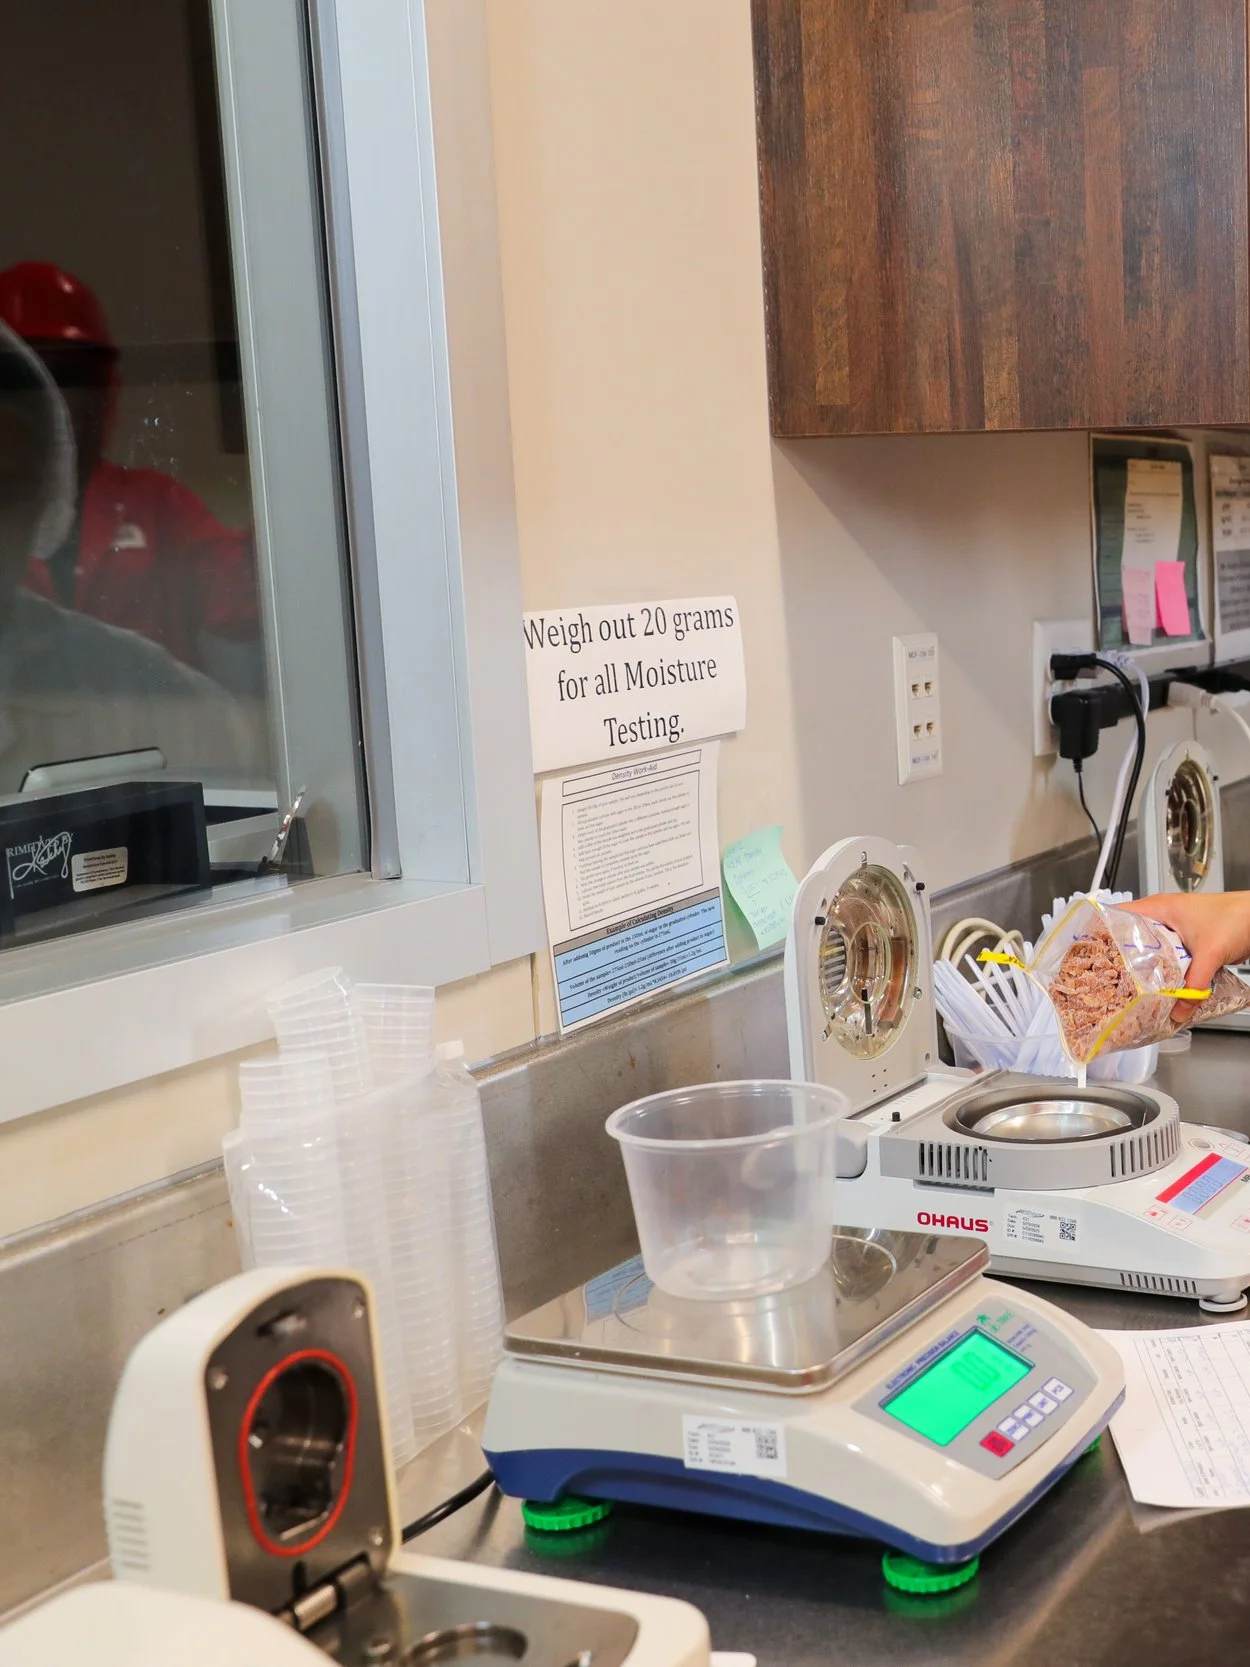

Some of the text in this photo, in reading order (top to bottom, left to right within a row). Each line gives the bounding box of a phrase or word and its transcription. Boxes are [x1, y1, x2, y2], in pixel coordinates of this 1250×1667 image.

[523, 606, 734, 654] Weigh out 20 grams
[557, 657, 718, 702] for all Moisture
[603, 711, 685, 747] Testing.
[611, 768, 631, 781] Density
[606, 922, 626, 935] Example
[631, 911, 656, 926] Calculating
[657, 905, 673, 916] Density
[569, 980, 584, 990] Volume
[587, 988, 601, 998] Density
[607, 993, 621, 1004] Density
[917, 1211, 989, 1232] OHAUS
